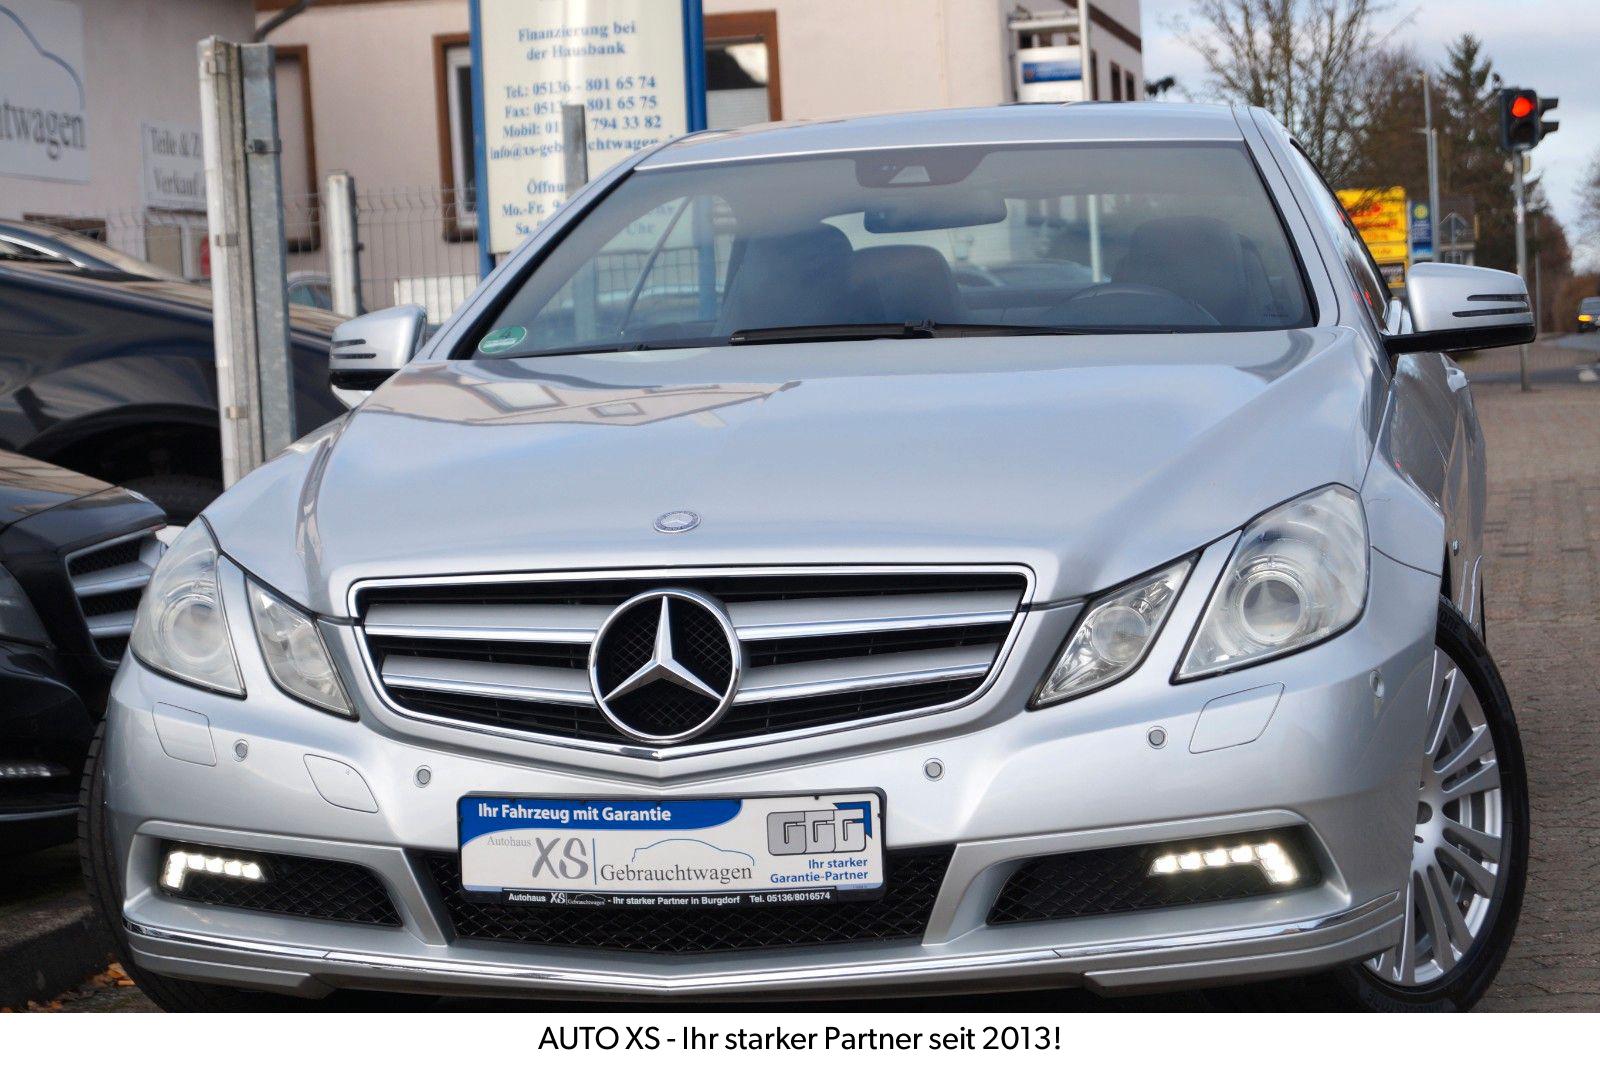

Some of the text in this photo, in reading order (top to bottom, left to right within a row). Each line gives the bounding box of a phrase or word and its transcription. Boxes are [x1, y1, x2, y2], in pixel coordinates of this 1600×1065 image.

[518, 20, 637, 42] Finanzierung bei
[526, 42, 625, 61] der Hausbank
[505, 85, 529, 98] Tel.:
[532, 81, 571, 96] 05136
[586, 77, 610, 91] 801
[616, 75, 634, 90] 65
[639, 73, 656, 89] 74
[505, 105, 529, 118] Fax:
[587, 97, 611, 111] 801
[617, 95, 635, 110] 65
[640, 95, 657, 111] 75
[0, 102, 86, 161] twagen
[503, 121, 541, 138] Mobil:
[591, 117, 617, 130] 794
[623, 115, 640, 129] 33
[644, 115, 662, 128] 82
[478, 803, 671, 823] Ihr Fahrzeug mit Garantie
[486, 836, 532, 847] Autohaus
[532, 837, 589, 880] XS
[808, 857, 868, 869] Ihr starker
[600, 864, 753, 885] Gebrauchtwagen
[770, 871, 869, 884] Garantie-Partner
[508, 892, 546, 902] Autohaus
[550, 892, 566, 904] XS
[613, 896, 624, 904] Ihr
[626, 897, 656, 905] starker
[657, 896, 689, 905] Partner
[691, 897, 699, 905] in
[701, 895, 740, 906] Burgdorf
[749, 895, 765, 903] Tel.
[766, 892, 831, 903] 05136/8016574
